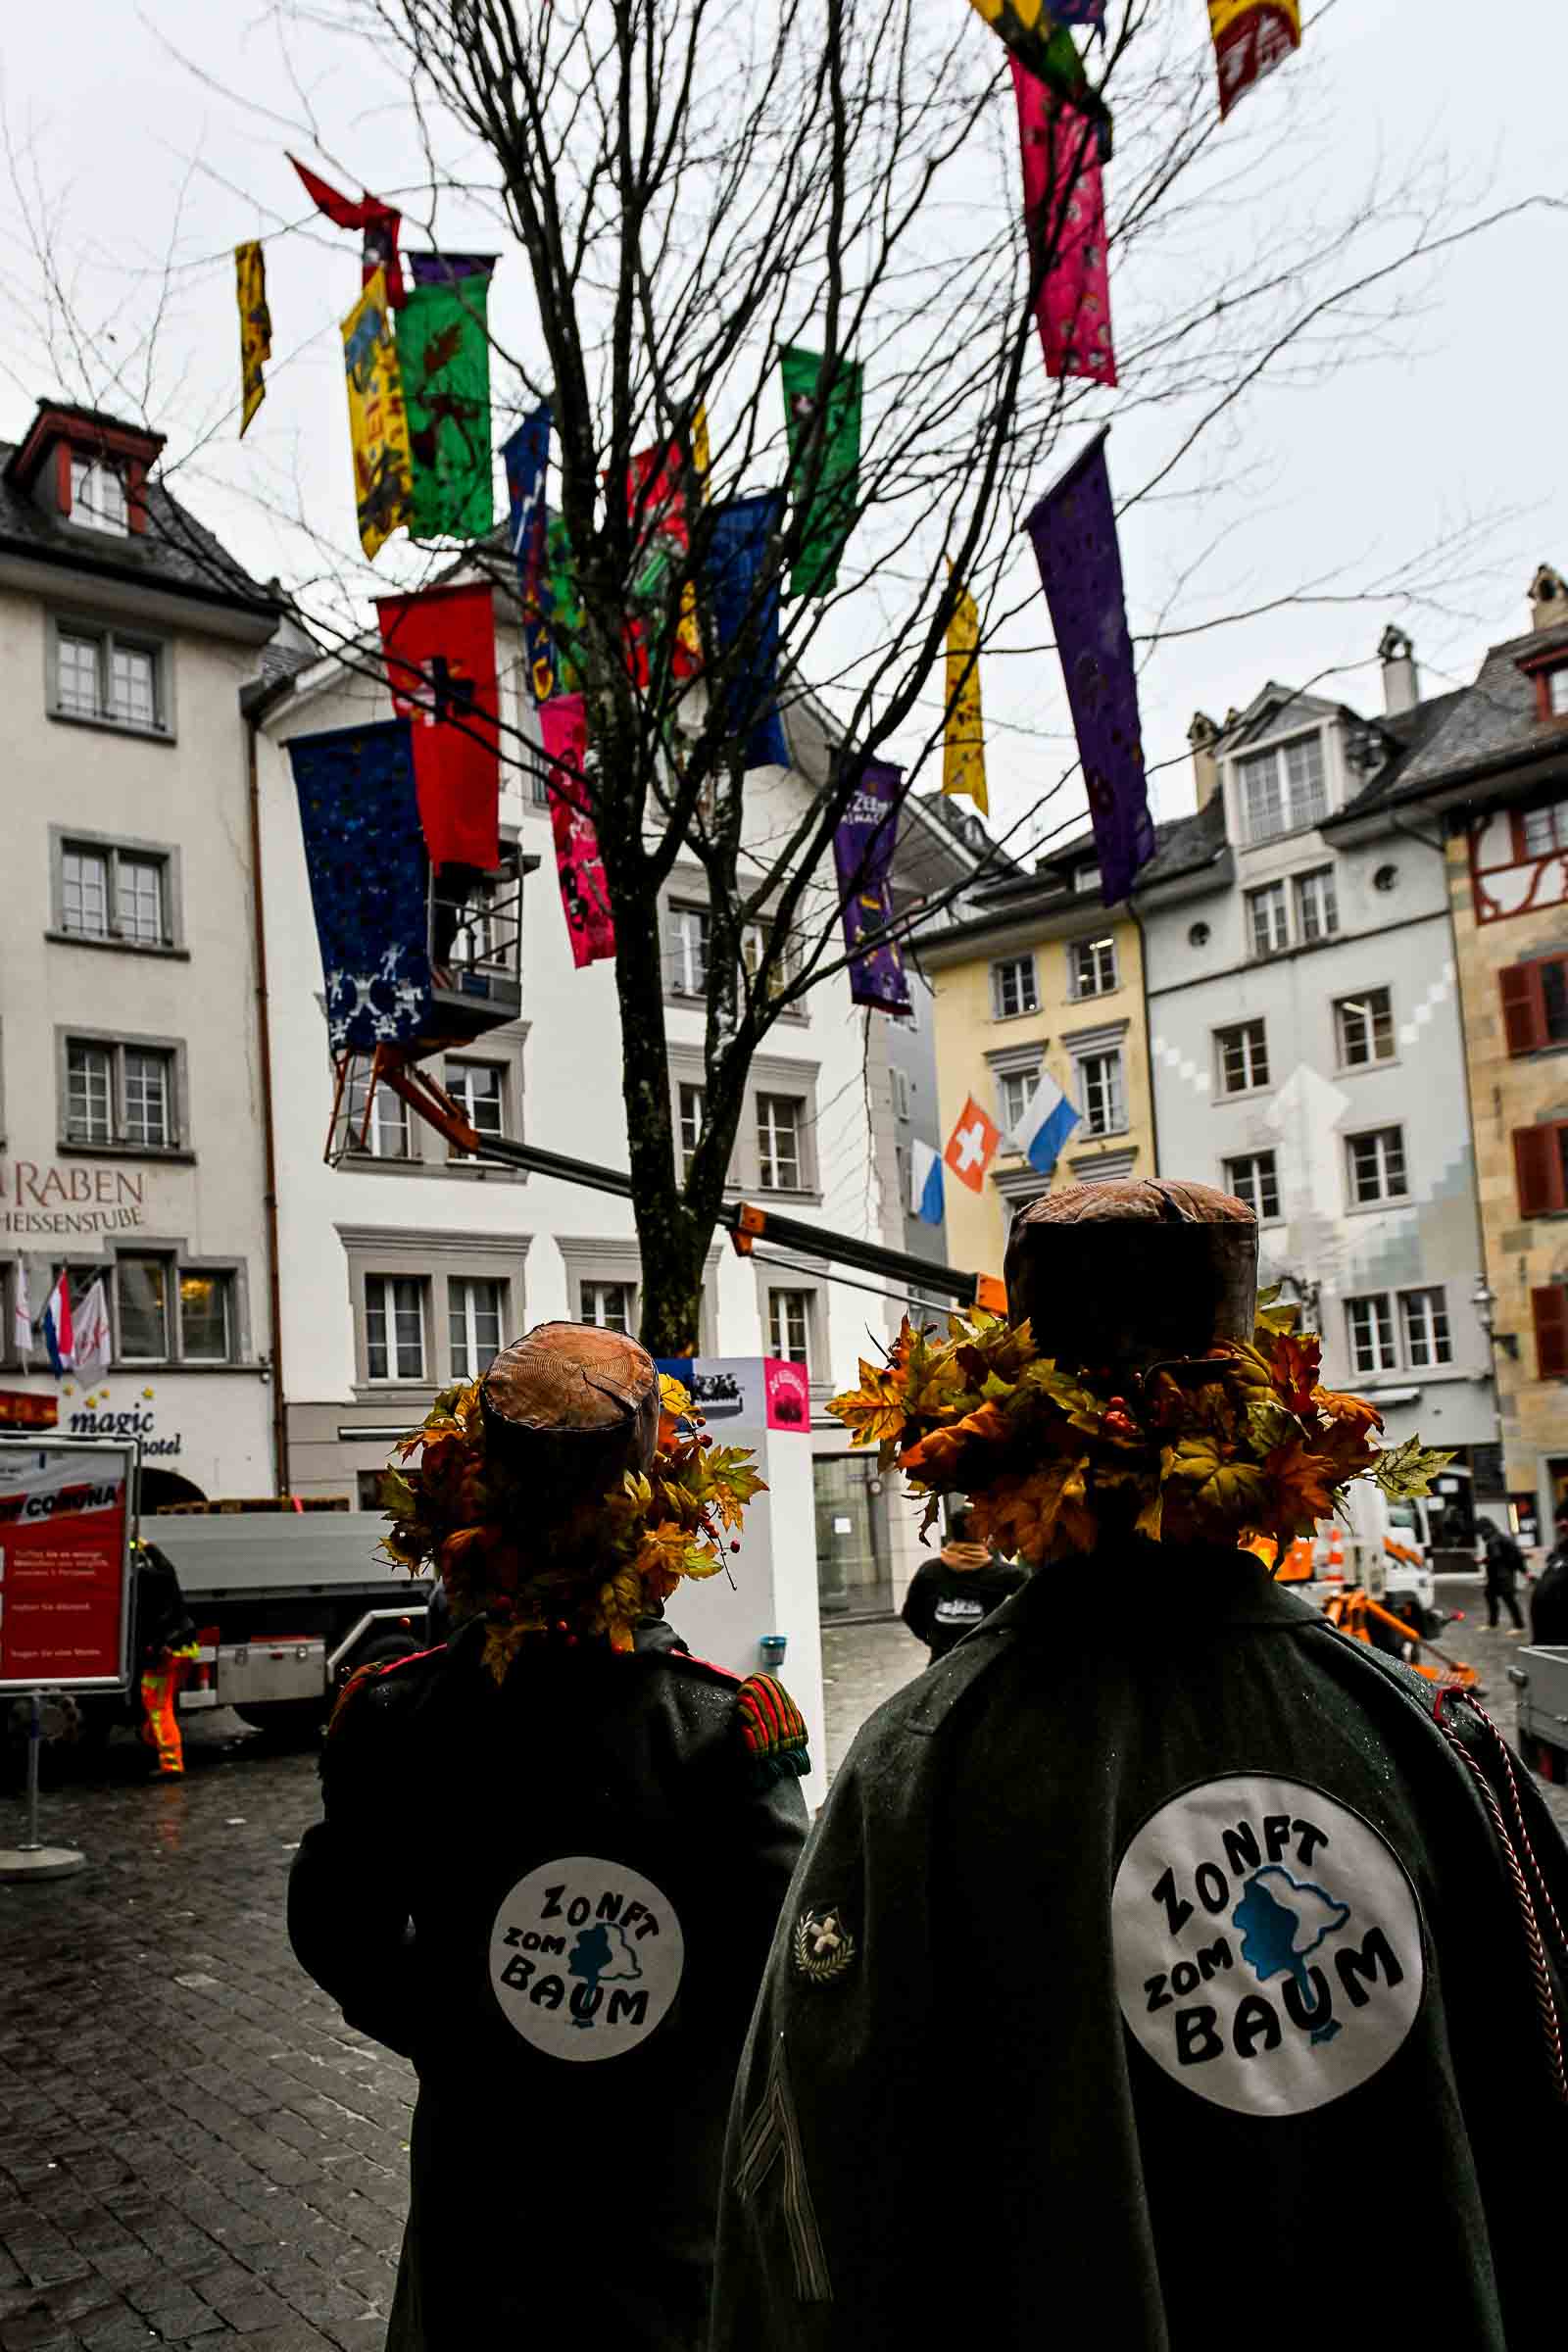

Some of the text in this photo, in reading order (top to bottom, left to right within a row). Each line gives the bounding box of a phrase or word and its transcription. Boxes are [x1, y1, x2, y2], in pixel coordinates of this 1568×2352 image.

[15, 1160, 142, 1207] RABEN
[70, 1402, 154, 1435] magic
[26, 1487, 118, 1516] CORONA
[1152, 1814, 1329, 1936] ZONFT
[541, 1885, 660, 1940] ZONFT
[503, 1927, 566, 1955] ZOM
[500, 1953, 650, 2026] BAUM
[1143, 1937, 1234, 2013] ZOM
[1174, 1926, 1404, 2065] BAUM
